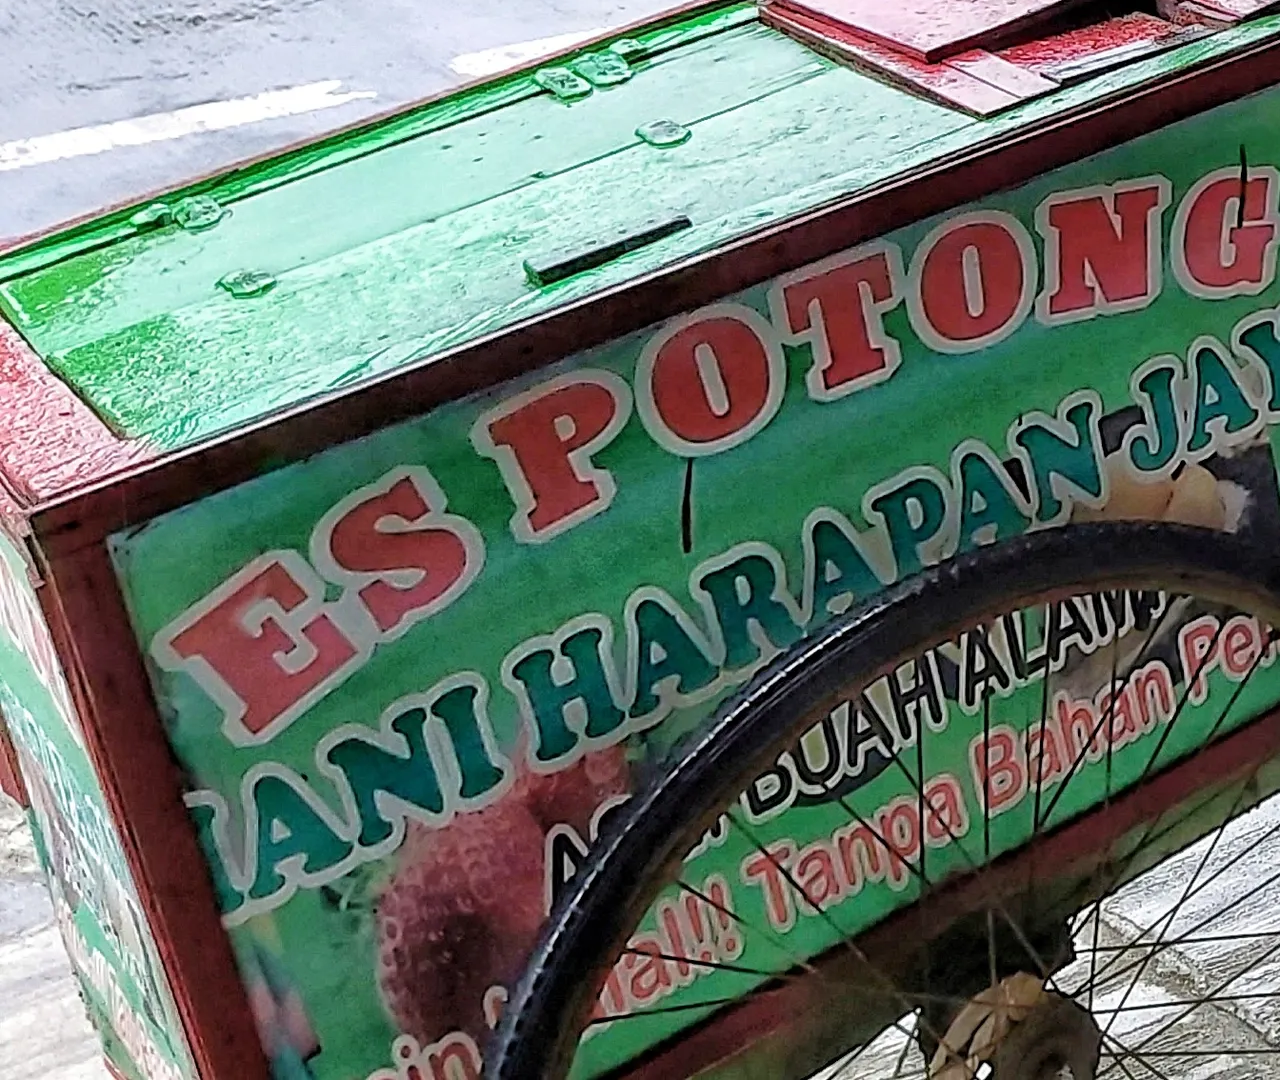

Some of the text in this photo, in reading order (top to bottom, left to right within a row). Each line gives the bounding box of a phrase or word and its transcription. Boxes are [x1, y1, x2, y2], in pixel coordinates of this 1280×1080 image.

[158, 468, 478, 740] ES
[508, 396, 1108, 763] HARAPAN
[740, 773, 969, 933] Tanpa
[968, 658, 1176, 815] Bahan
